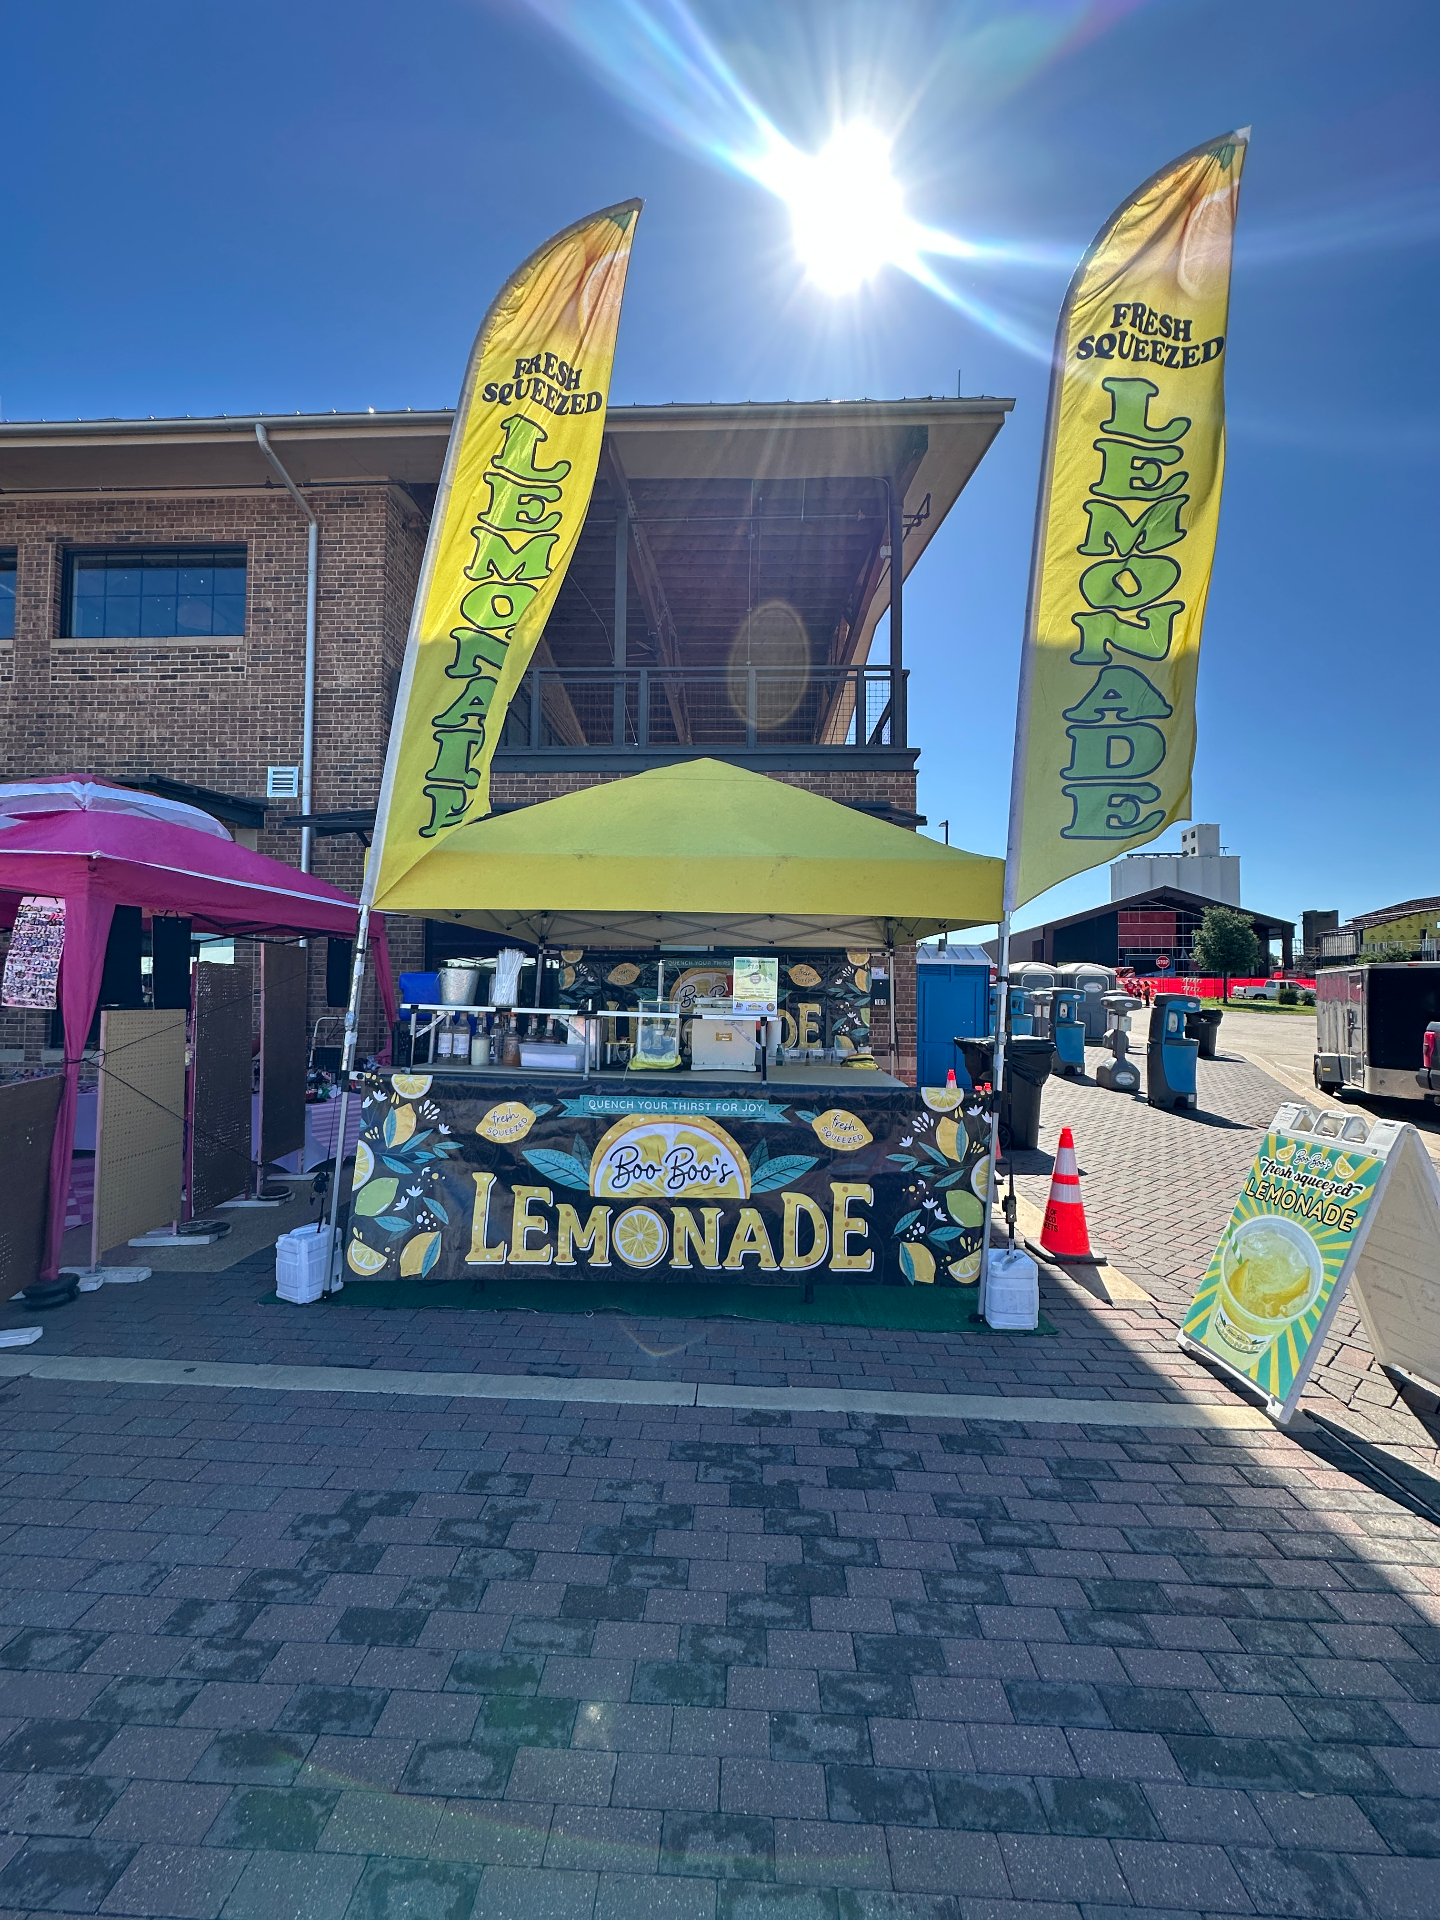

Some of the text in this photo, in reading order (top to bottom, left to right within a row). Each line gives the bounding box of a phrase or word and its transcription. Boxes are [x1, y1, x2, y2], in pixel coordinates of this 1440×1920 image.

[1110, 302, 1193, 342] FRESH
[1076, 330, 1225, 369] SQUEEZED
[512, 352, 582, 391] FRESH
[482, 377, 603, 415] SQUEEZED
[1060, 377, 1192, 840] LEMONADE
[491, 1107, 520, 1127] fresh
[588, 1099, 763, 1112] QUENCH YOUR THIRST FOR JOY
[832, 1115, 858, 1131] fresh
[486, 1117, 528, 1138] SQUEEZED
[821, 1126, 864, 1143] SQUEEZED
[610, 1146, 734, 1190] Boo Boo's
[1293, 1172, 1364, 1198] squeezed
[465, 1172, 874, 1272] LEMONADE
[1245, 1177, 1358, 1233] LEMONADE
